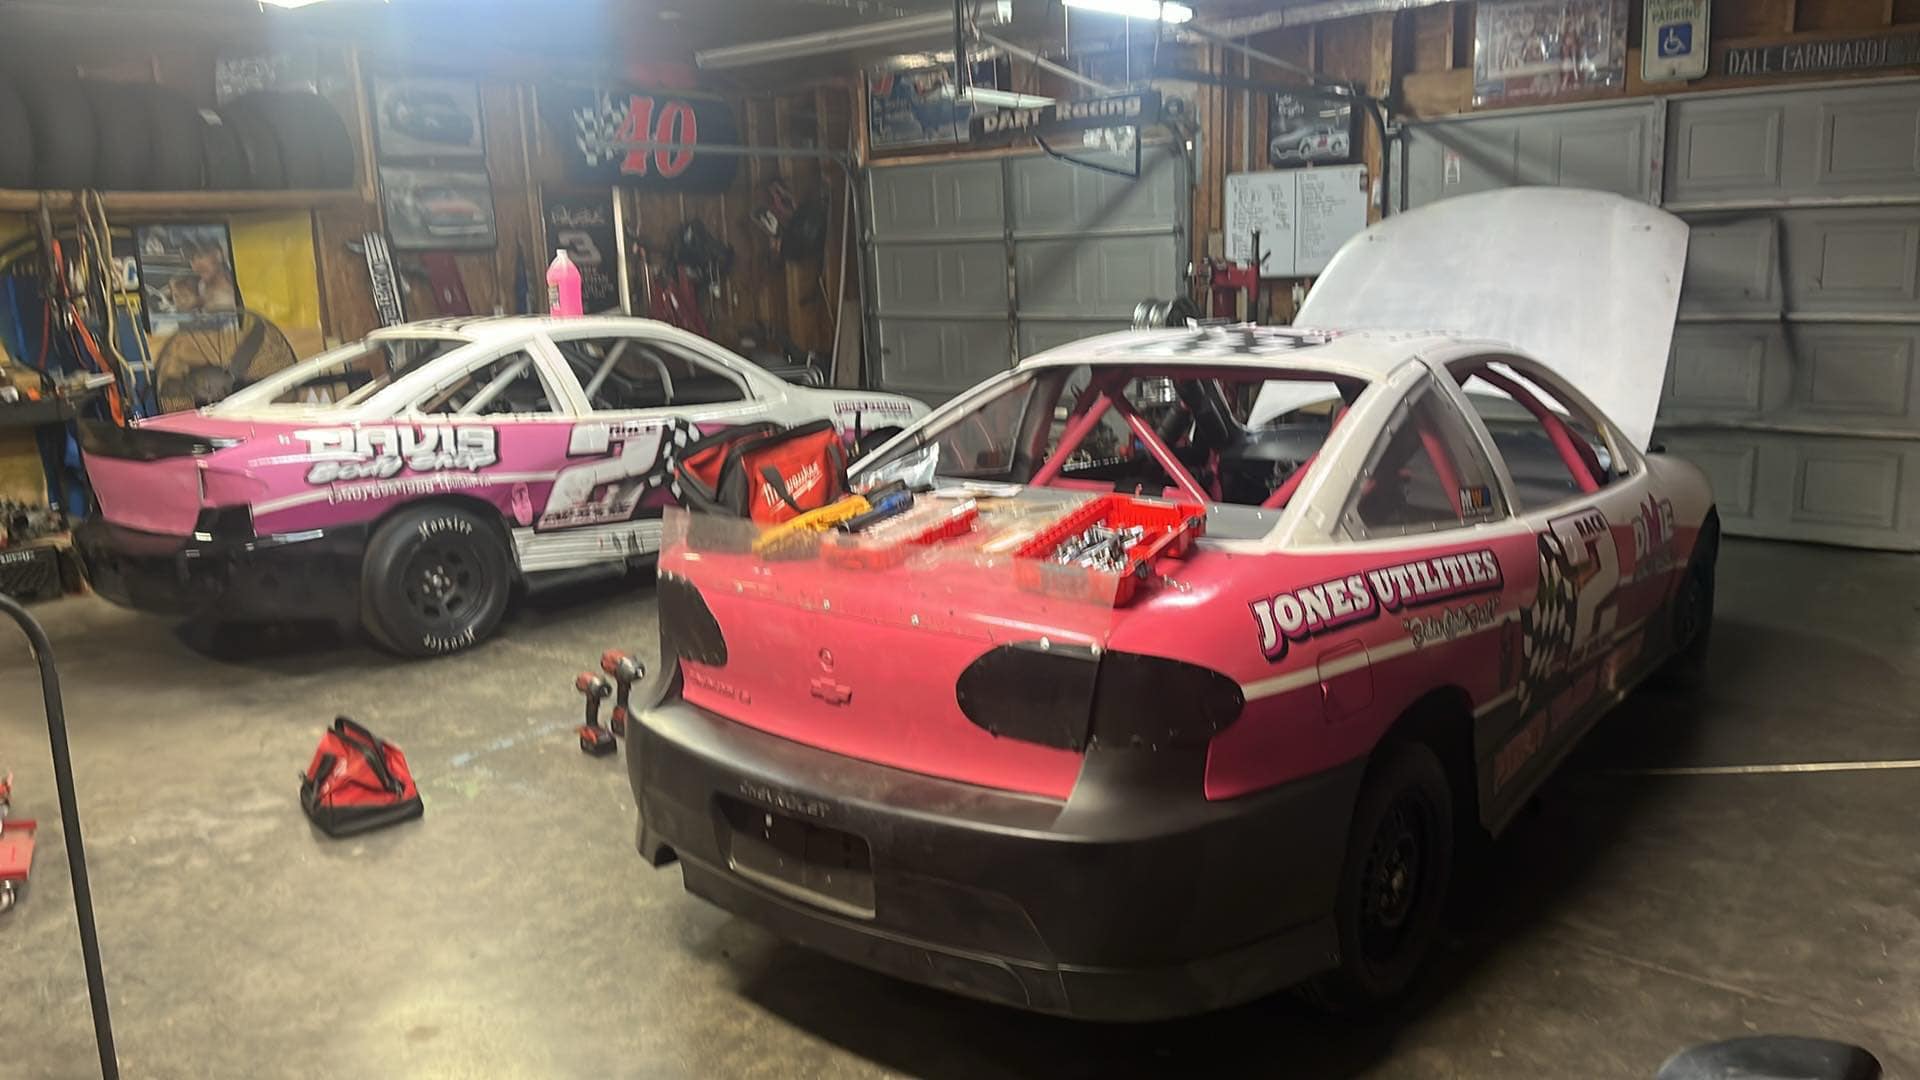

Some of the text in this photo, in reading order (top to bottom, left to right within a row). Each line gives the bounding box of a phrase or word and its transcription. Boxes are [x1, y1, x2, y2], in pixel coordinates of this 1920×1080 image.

[612, 95, 697, 178] 40
[983, 96, 1140, 134] DART Racing
[1252, 573, 1374, 653] JONES
[1367, 549, 1500, 604] UTILITIES
